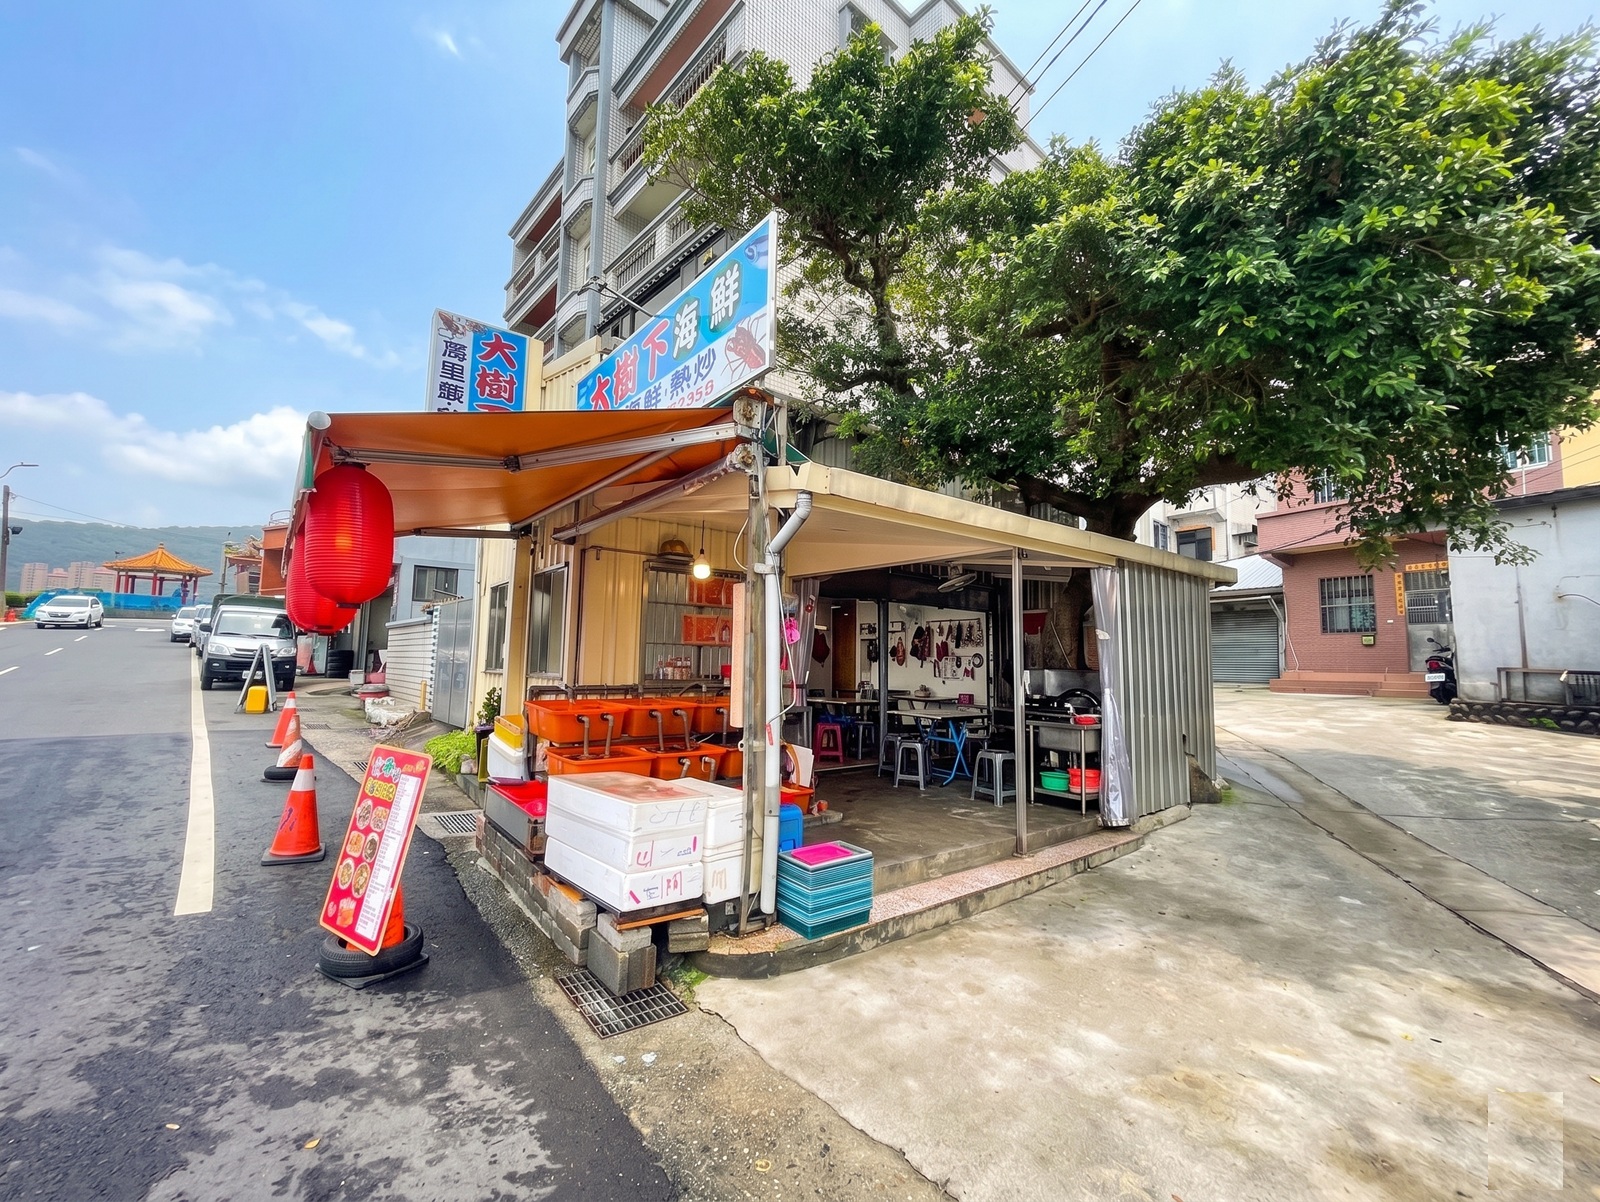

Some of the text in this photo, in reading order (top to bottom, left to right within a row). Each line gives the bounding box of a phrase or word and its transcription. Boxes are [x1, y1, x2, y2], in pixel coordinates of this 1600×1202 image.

[590, 263, 739, 409] 大樹下海鮮
